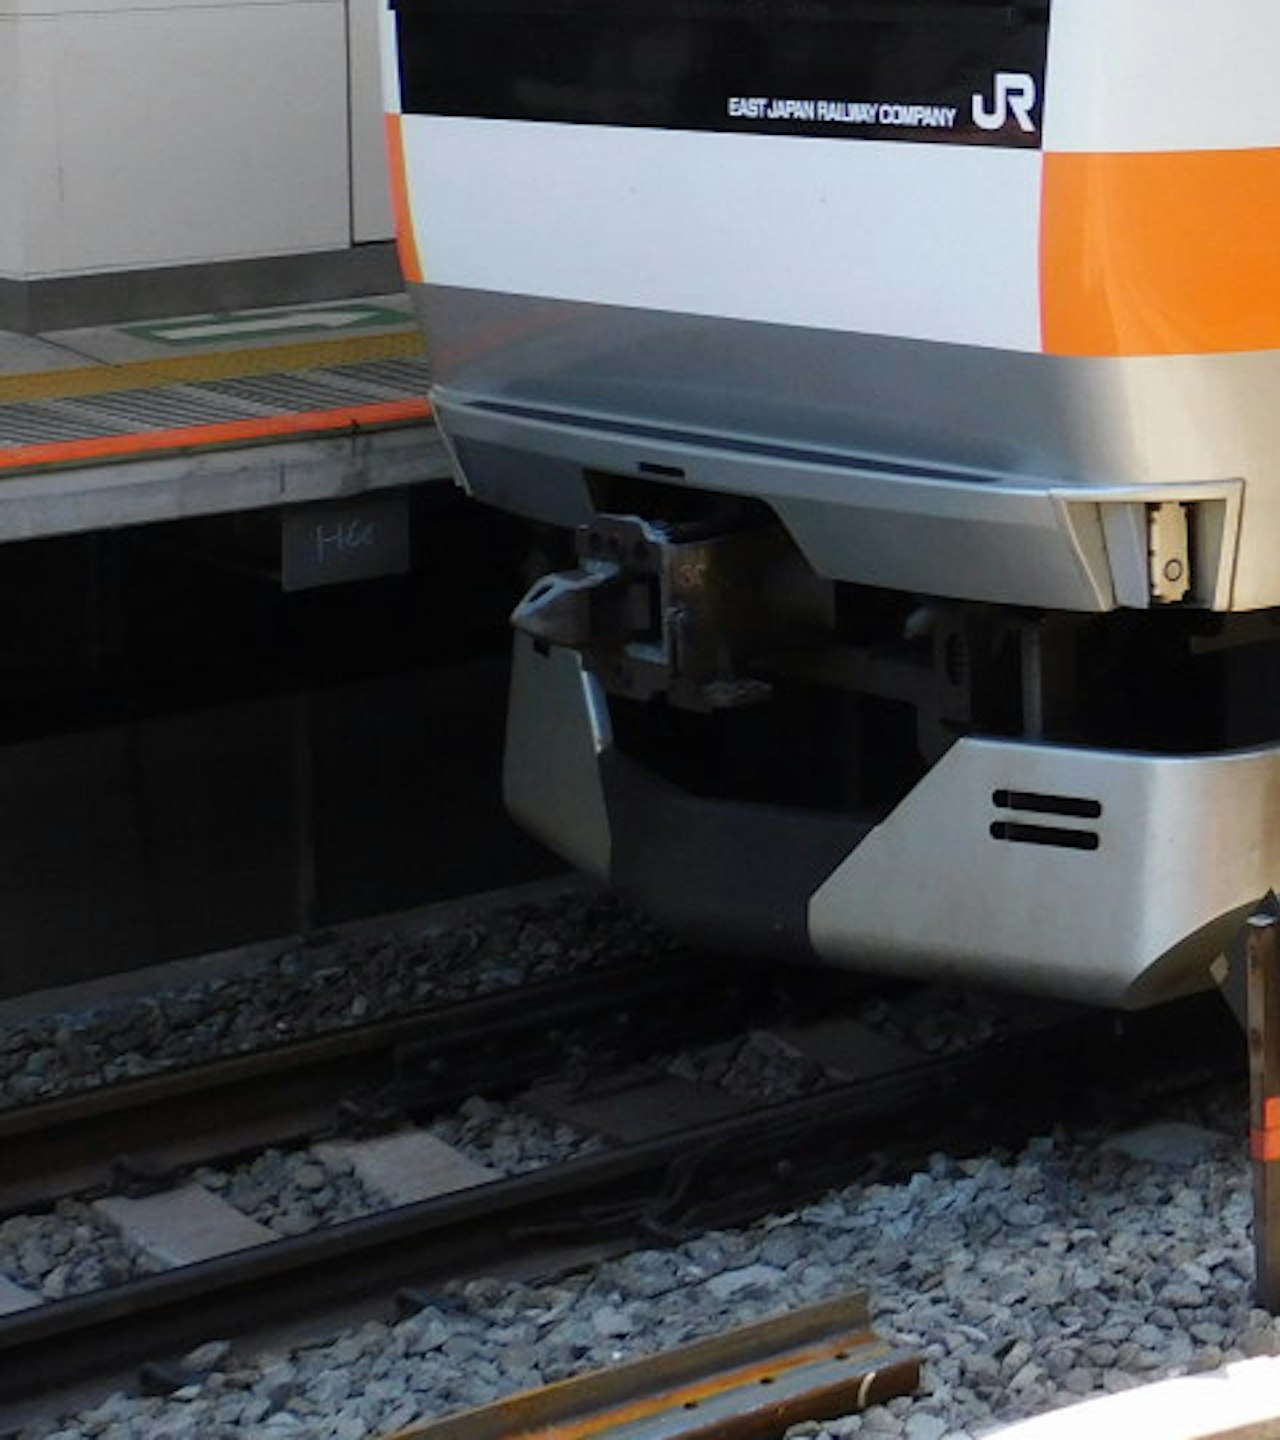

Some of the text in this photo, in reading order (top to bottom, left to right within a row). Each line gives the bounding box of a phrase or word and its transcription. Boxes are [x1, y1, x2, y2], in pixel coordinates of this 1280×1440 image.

[727, 97, 957, 128] EAST JAPAN RAILWAY COMPANY
[971, 73, 1036, 132] JR
